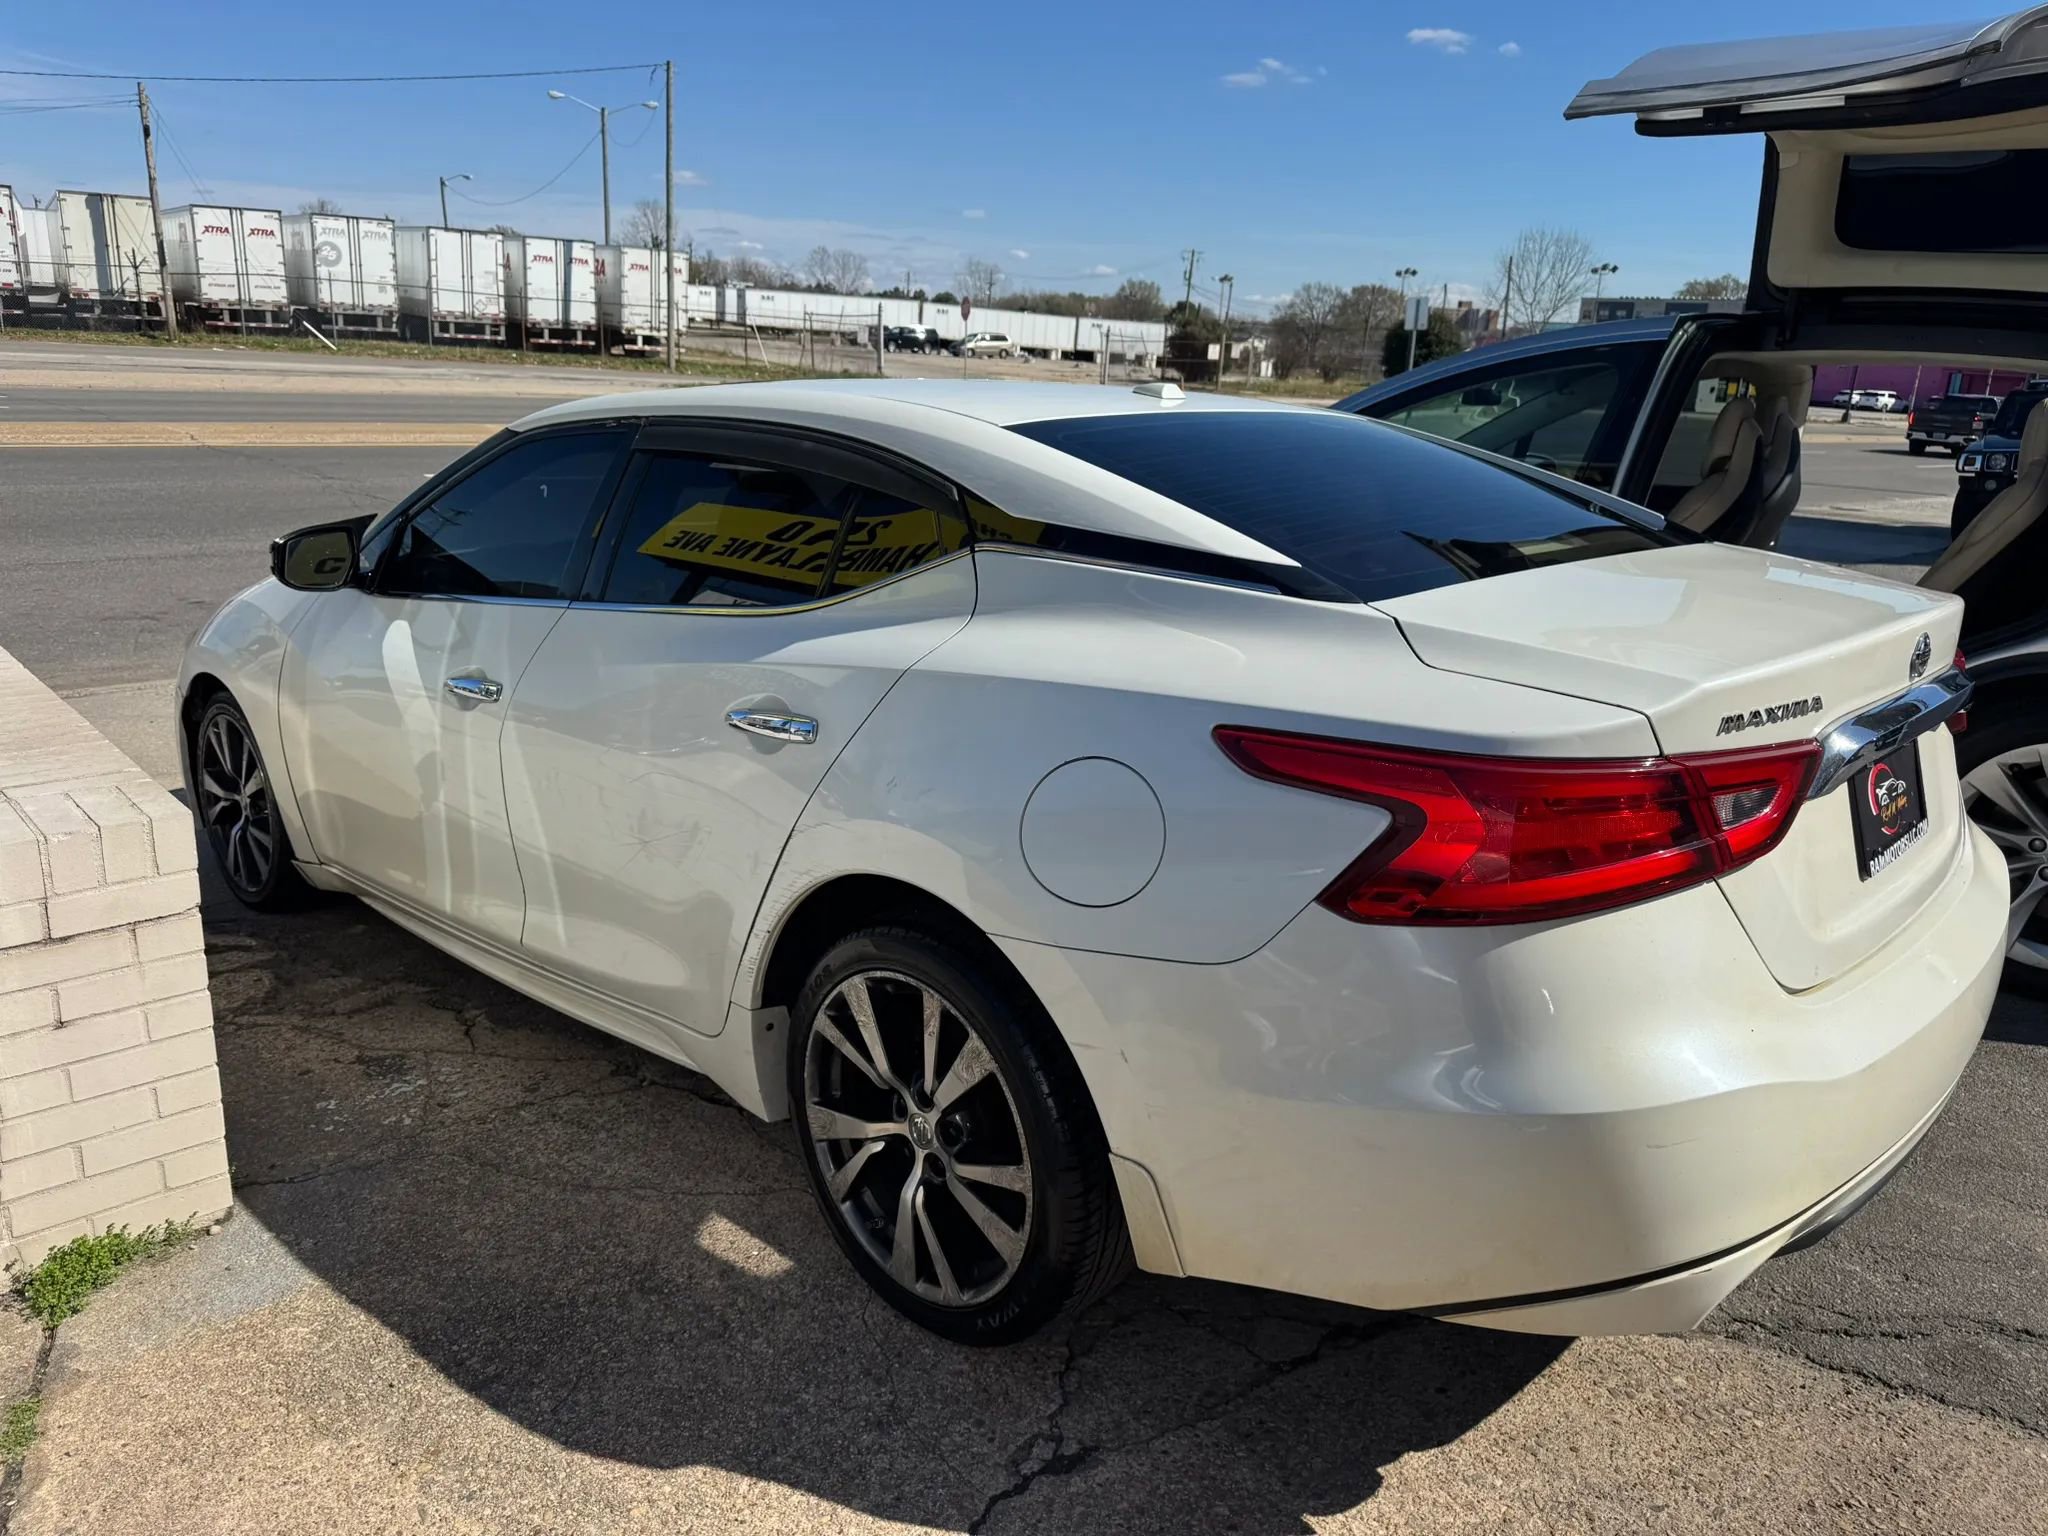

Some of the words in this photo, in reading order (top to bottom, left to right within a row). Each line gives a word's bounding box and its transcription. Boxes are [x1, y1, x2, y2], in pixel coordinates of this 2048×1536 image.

[201, 225, 231, 235] XTRA
[247, 227, 276, 237] XTRA
[319, 227, 346, 237] XTRA
[361, 230, 388, 240] XTRA
[320, 245, 337, 260] 25
[531, 254, 553, 263] XTRA
[567, 257, 590, 265] XTRA
[628, 263, 650, 272] XTRA
[1716, 695, 1824, 736] MAXIMA
